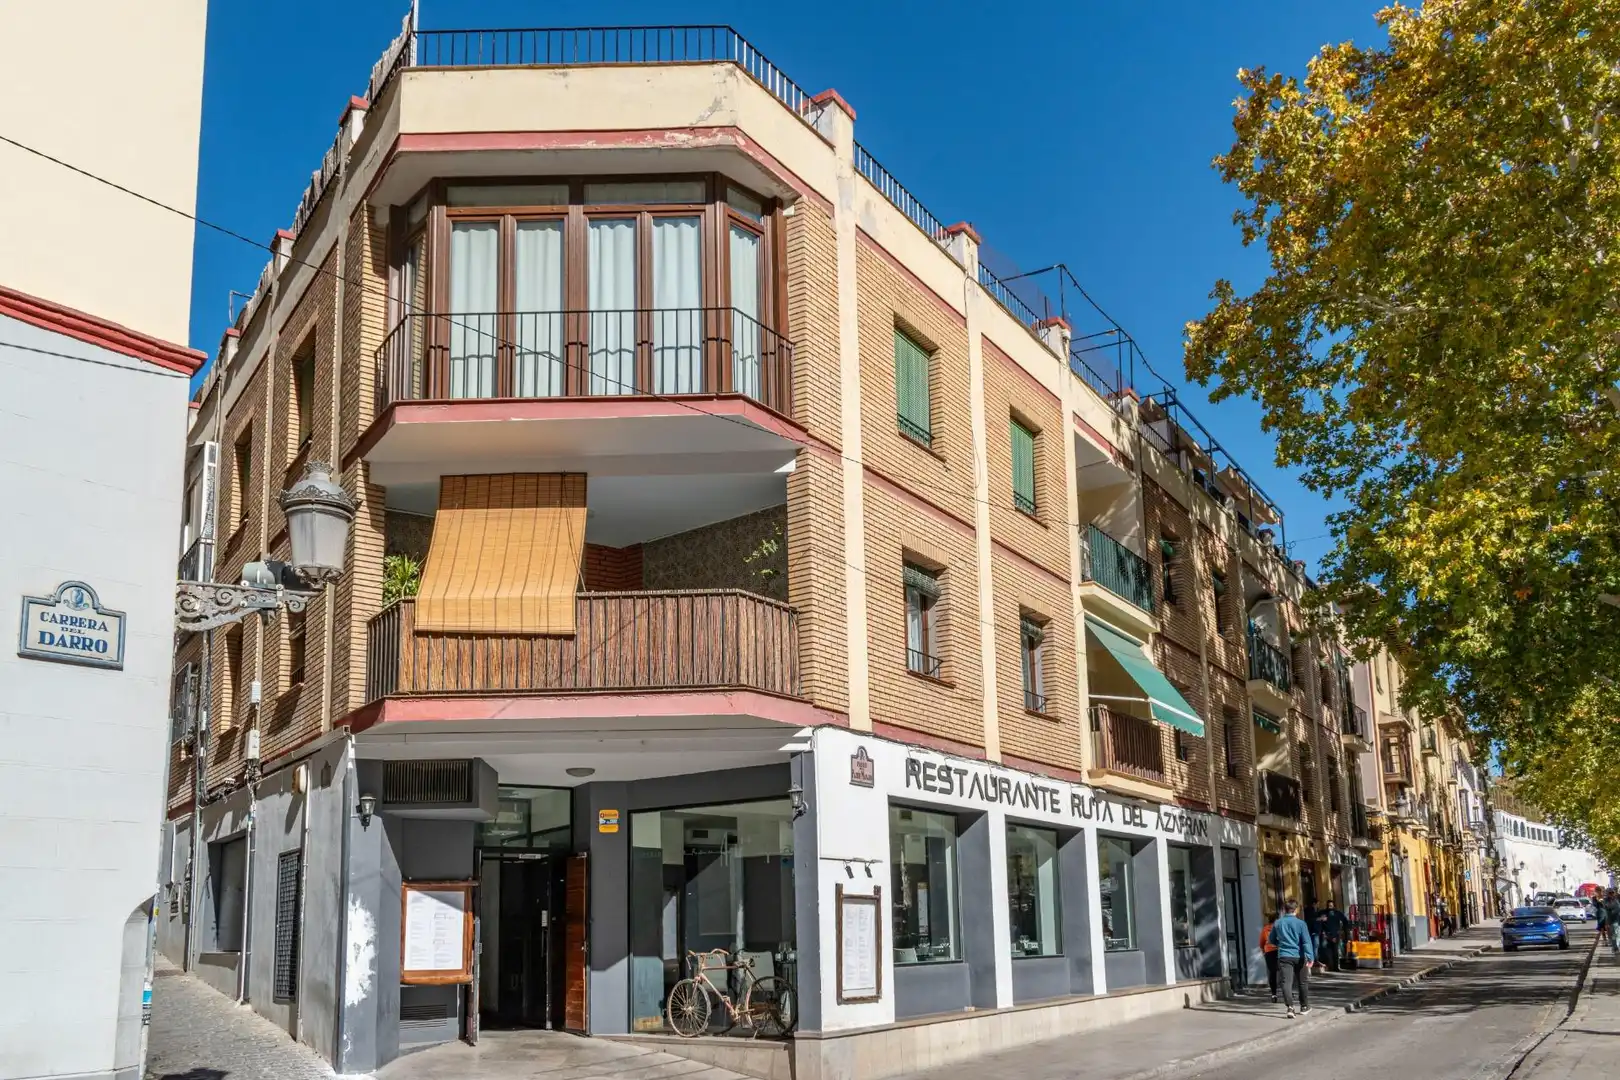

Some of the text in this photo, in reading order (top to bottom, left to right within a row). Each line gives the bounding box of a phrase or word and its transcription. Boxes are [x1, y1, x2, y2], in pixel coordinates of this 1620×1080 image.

[40, 611, 109, 632] CARRERA
[61, 626, 85, 635] DEL
[38, 630, 108, 654] DARRO
[905, 757, 1061, 814] RESTAURANTE
[1071, 793, 1114, 823] RUTA
[1121, 804, 1148, 828] DEL
